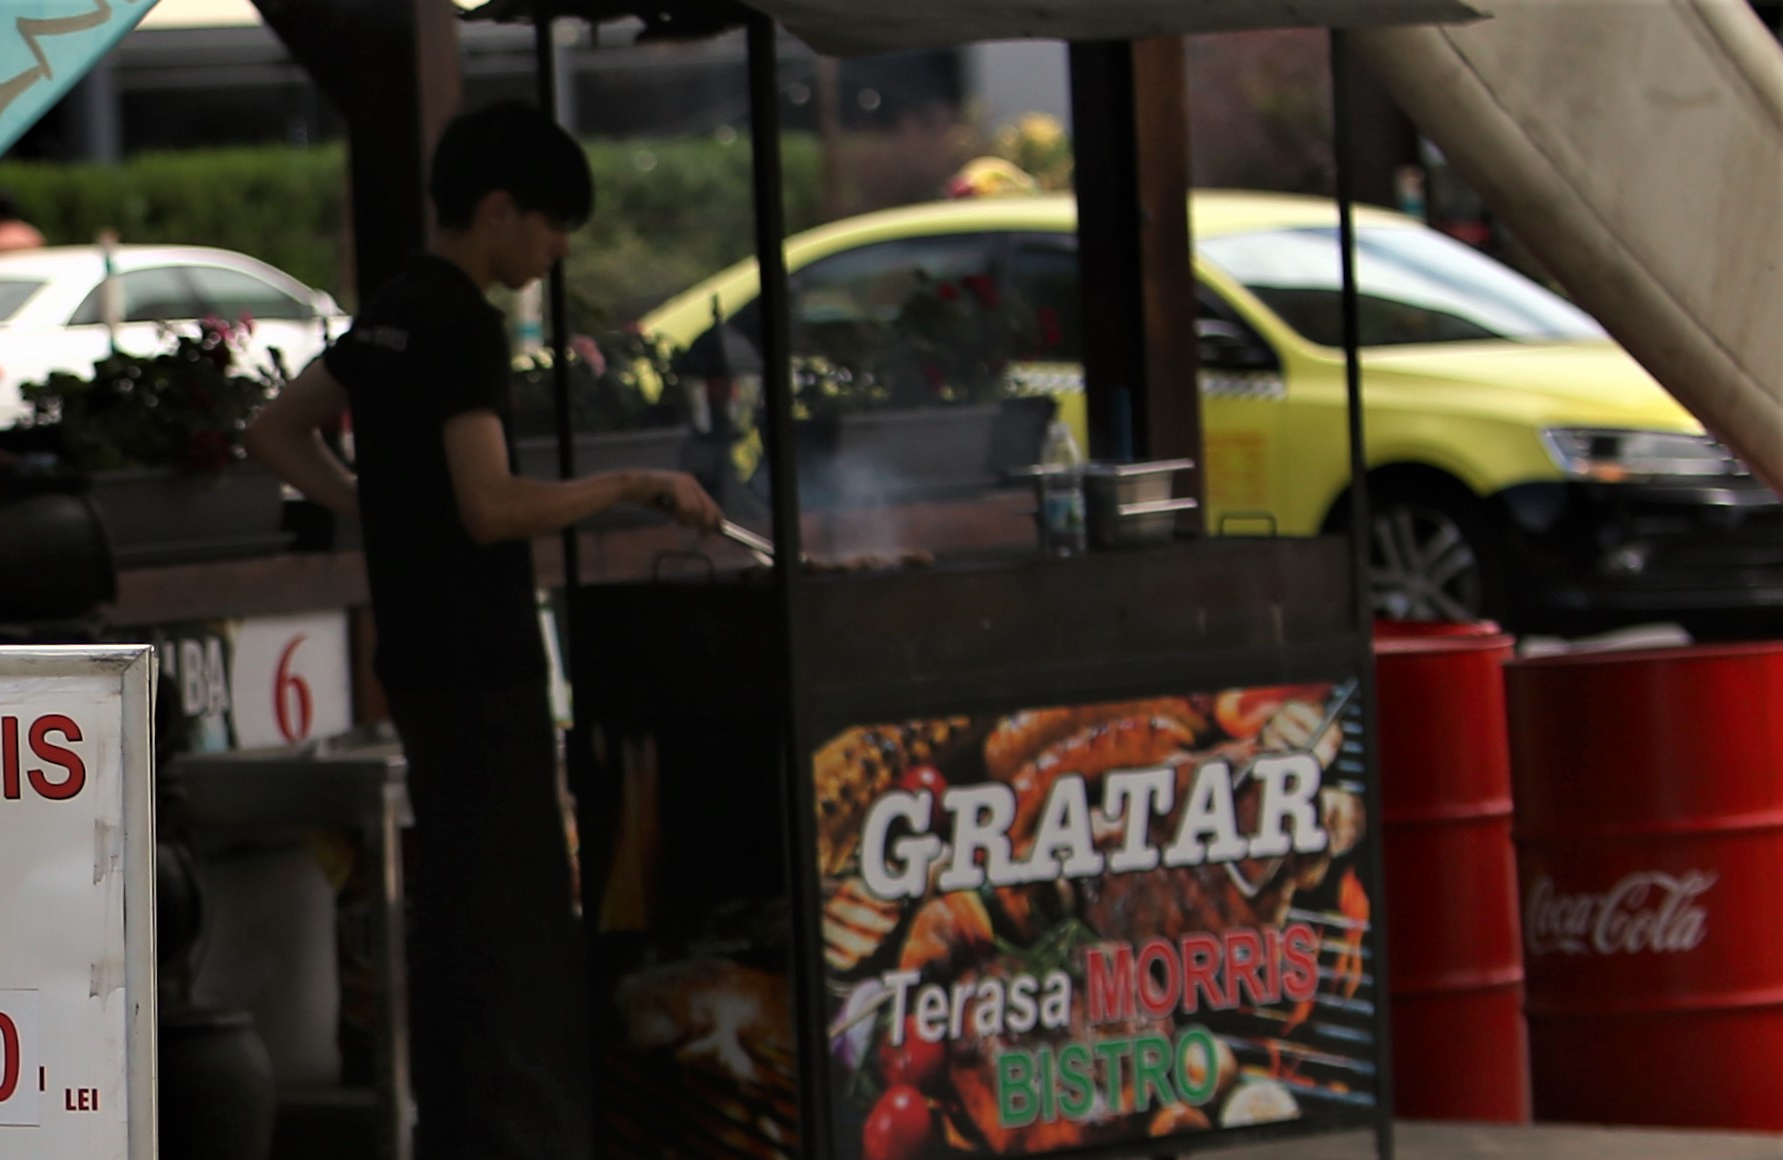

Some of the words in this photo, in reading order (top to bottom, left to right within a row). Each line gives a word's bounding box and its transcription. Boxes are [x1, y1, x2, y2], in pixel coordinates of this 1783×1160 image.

[274, 630, 314, 747] 6
[858, 753, 1328, 900] GRATAR
[882, 969, 1072, 1046] Terasa
[1085, 923, 1319, 1024] MORRIS
[66, 1089, 97, 1110] LEI
[997, 1024, 1220, 1129] BISTRO
